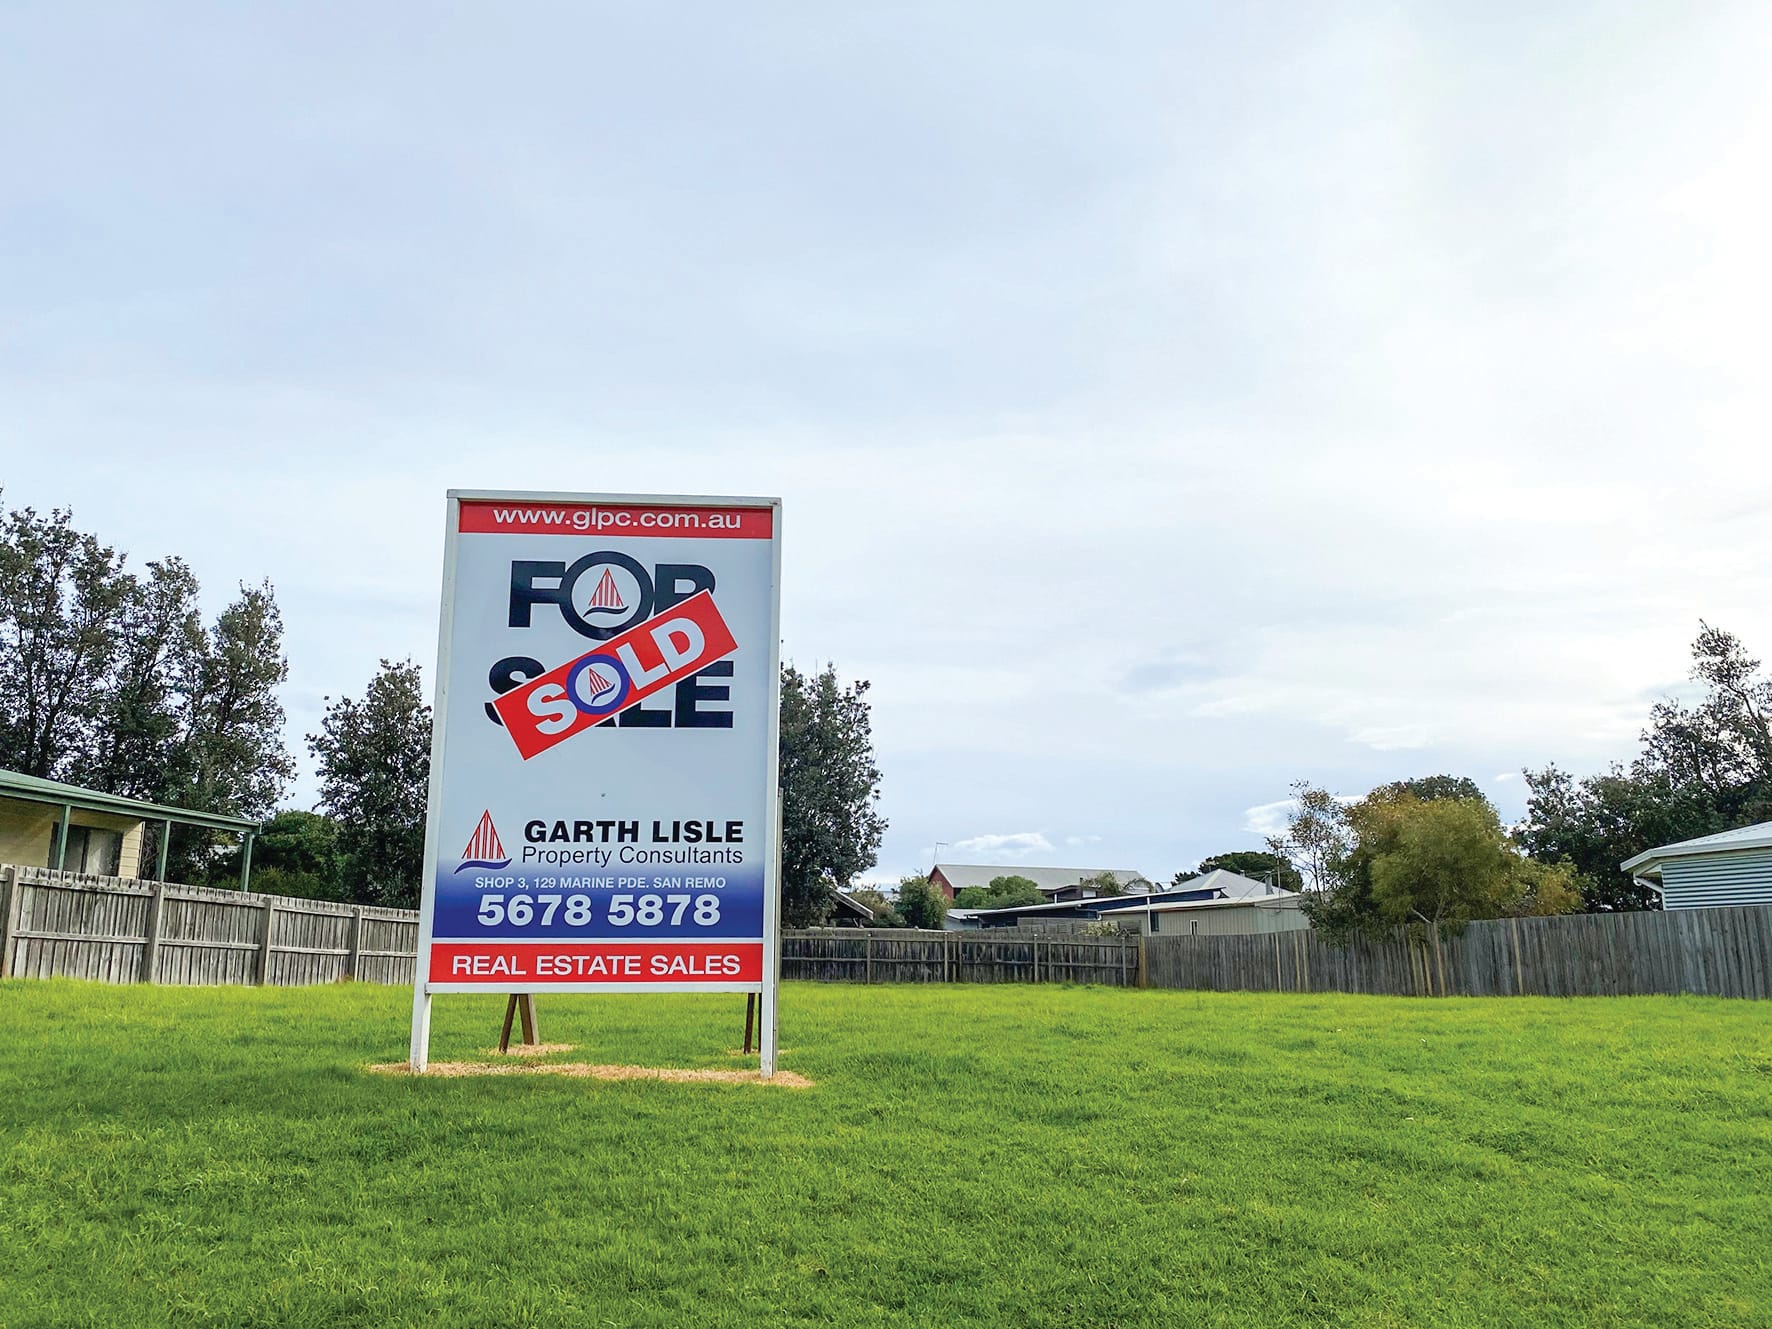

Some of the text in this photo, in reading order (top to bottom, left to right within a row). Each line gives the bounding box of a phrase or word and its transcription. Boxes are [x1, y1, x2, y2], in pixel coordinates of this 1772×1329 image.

[493, 507, 742, 530] www.glpc.com.au
[526, 617, 706, 735] SOLD
[523, 820, 744, 844] GARTH LISLE
[522, 846, 744, 868] Property Consultants
[474, 877, 726, 890] SHOP 3, 129 MARINE PDE. SAN REMO
[477, 894, 721, 927] 5678 5878
[452, 955, 742, 976] REAL ESTATE SALES
